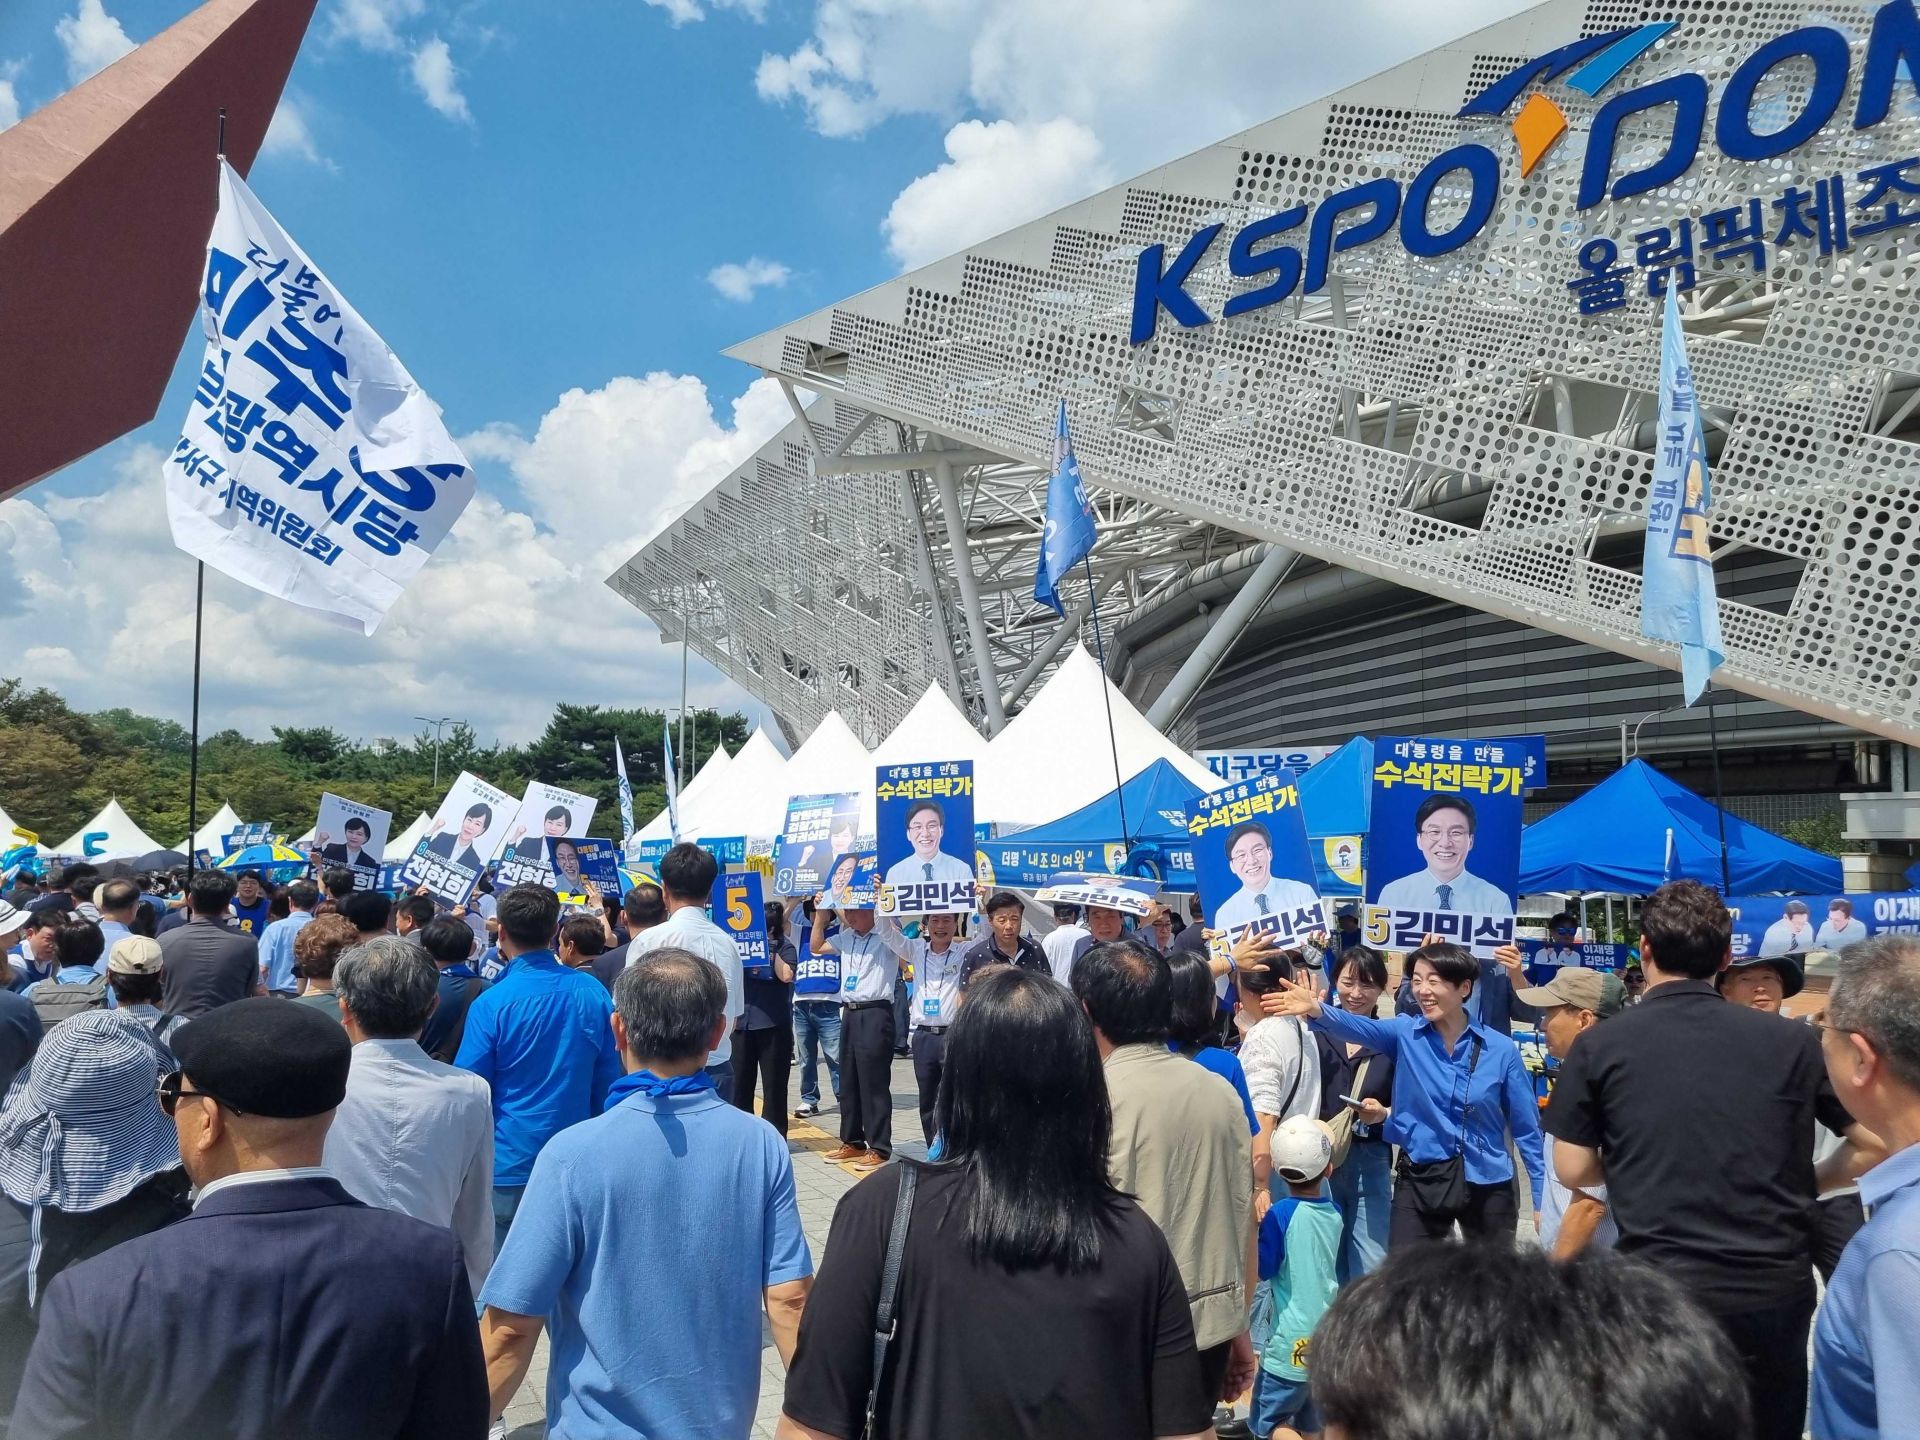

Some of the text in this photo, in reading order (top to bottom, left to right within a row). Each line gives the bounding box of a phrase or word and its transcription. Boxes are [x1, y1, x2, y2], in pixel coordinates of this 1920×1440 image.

[1130, 143, 1500, 346] KSPO
[1395, 743, 1505, 764] 대통령을 만들
[889, 763, 960, 779] 대통령을 만들
[1374, 761, 1524, 796] 수석전략가
[876, 777, 973, 802] 수석전략가
[1199, 775, 1280, 810] 대통령을 만들
[1188, 785, 1298, 836] 수석전략가
[416, 841, 429, 856] 8
[504, 847, 515, 862] 8
[402, 853, 472, 904] 전현희
[776, 867, 794, 894] 8
[727, 887, 752, 931] 5
[841, 886, 854, 905] 5
[880, 885, 896, 913] 5
[897, 881, 977, 912] 김민석
[1365, 907, 1391, 945] 5
[1394, 910, 1514, 953] 김민석
[1209, 929, 1230, 956] 5
[1582, 944, 1615, 955] 이재명
[796, 958, 840, 980] 전현희
[1584, 955, 1616, 967] 김민석
